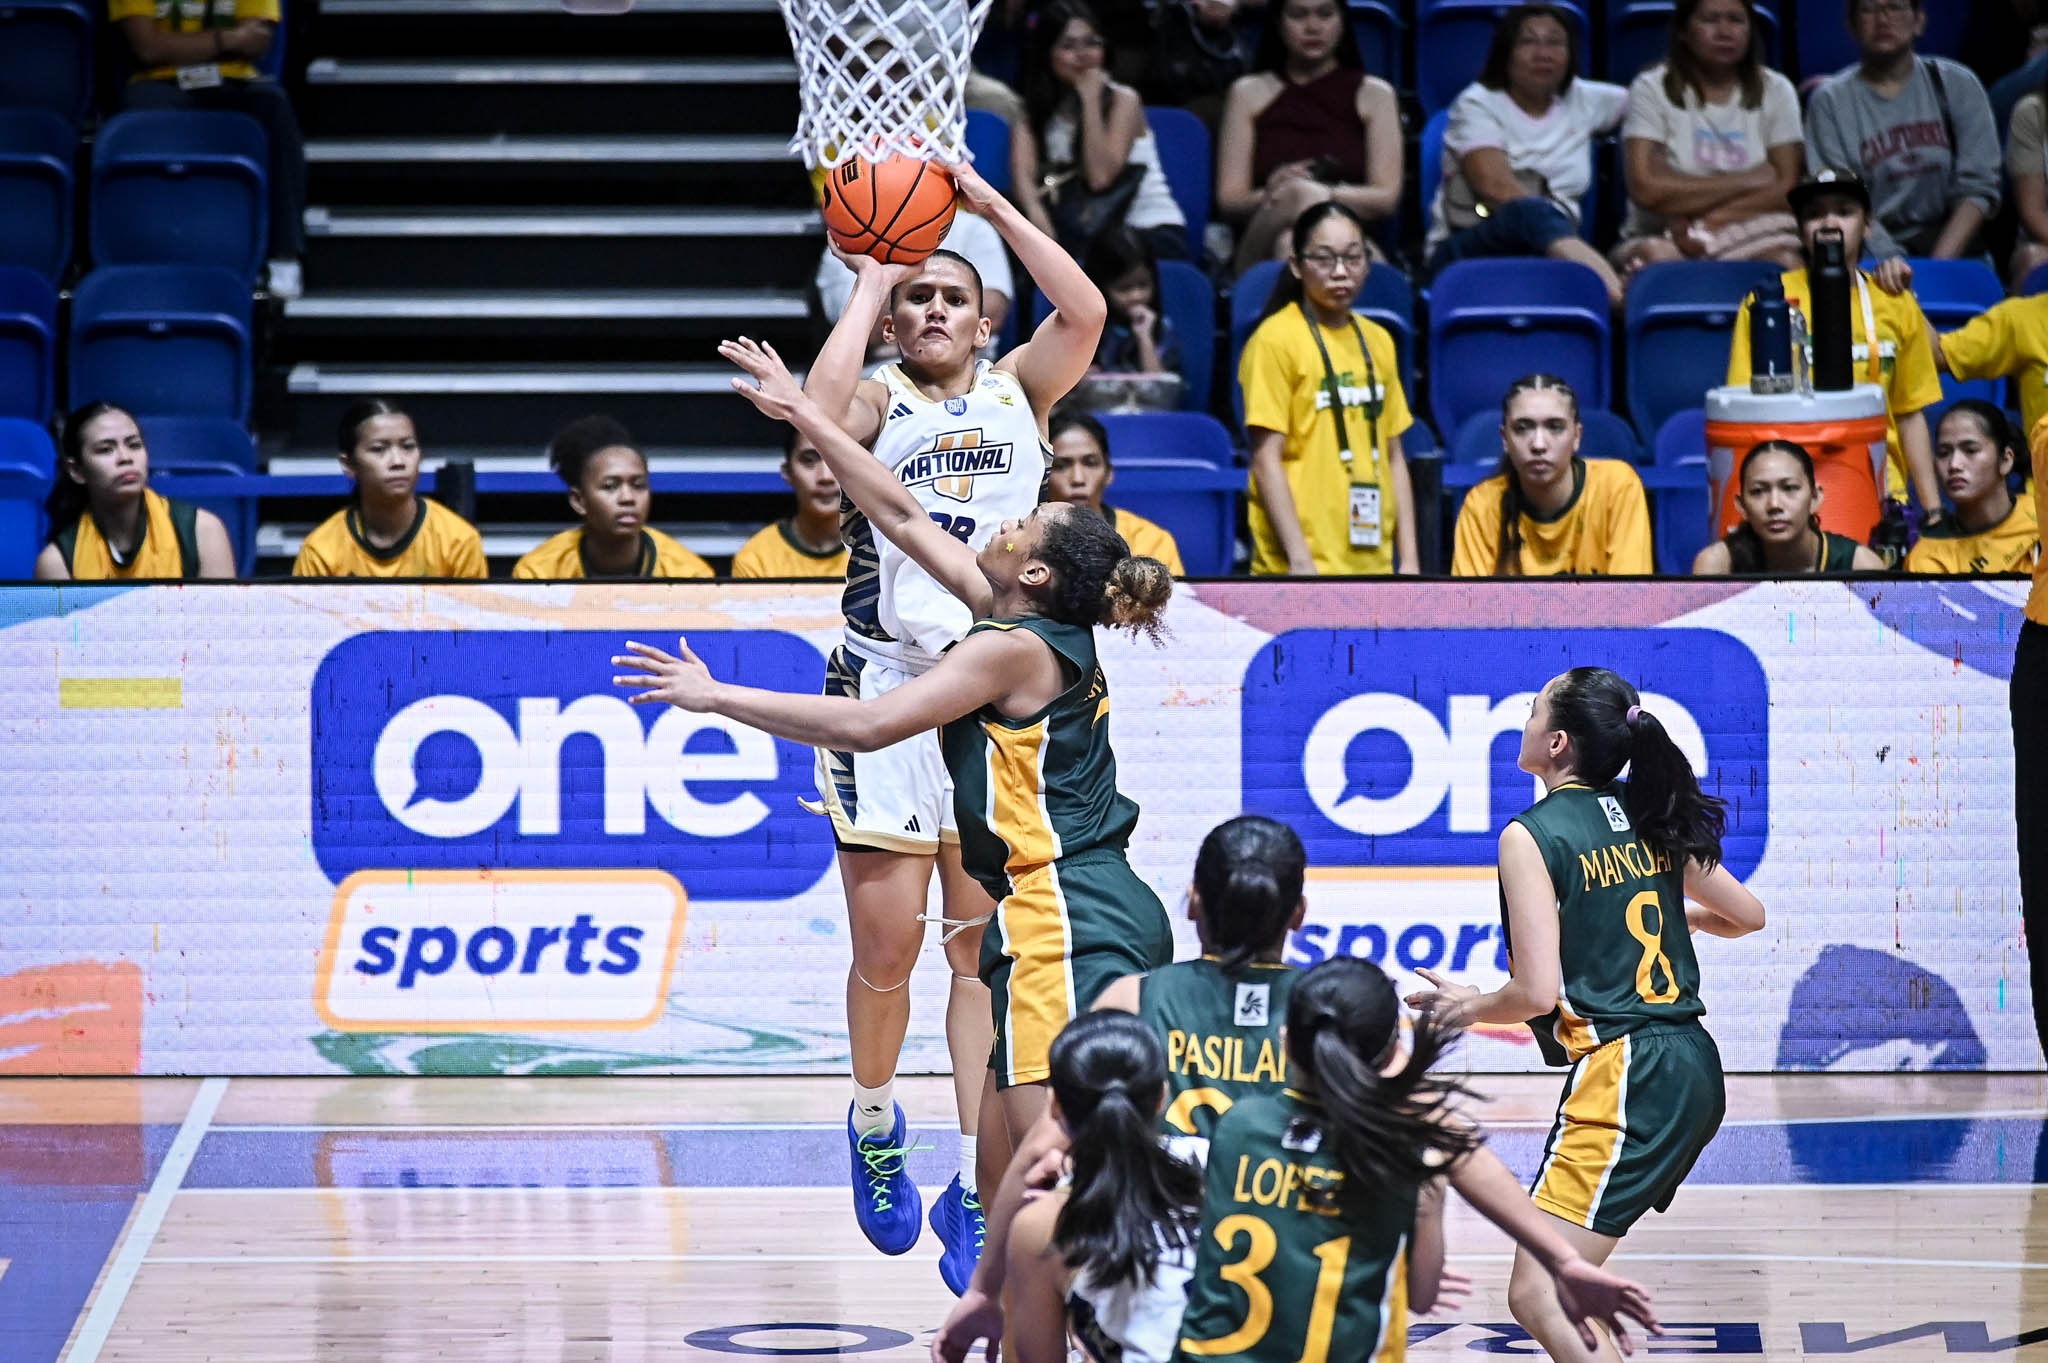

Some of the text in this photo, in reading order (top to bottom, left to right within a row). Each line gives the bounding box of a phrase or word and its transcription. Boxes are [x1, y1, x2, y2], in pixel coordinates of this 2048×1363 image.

[901, 448, 1006, 483] NATIONAL
[373, 693, 779, 838] one
[353, 914, 645, 989] sports
[1625, 890, 1680, 1005] 8
[1180, 1213, 1352, 1363] 31
